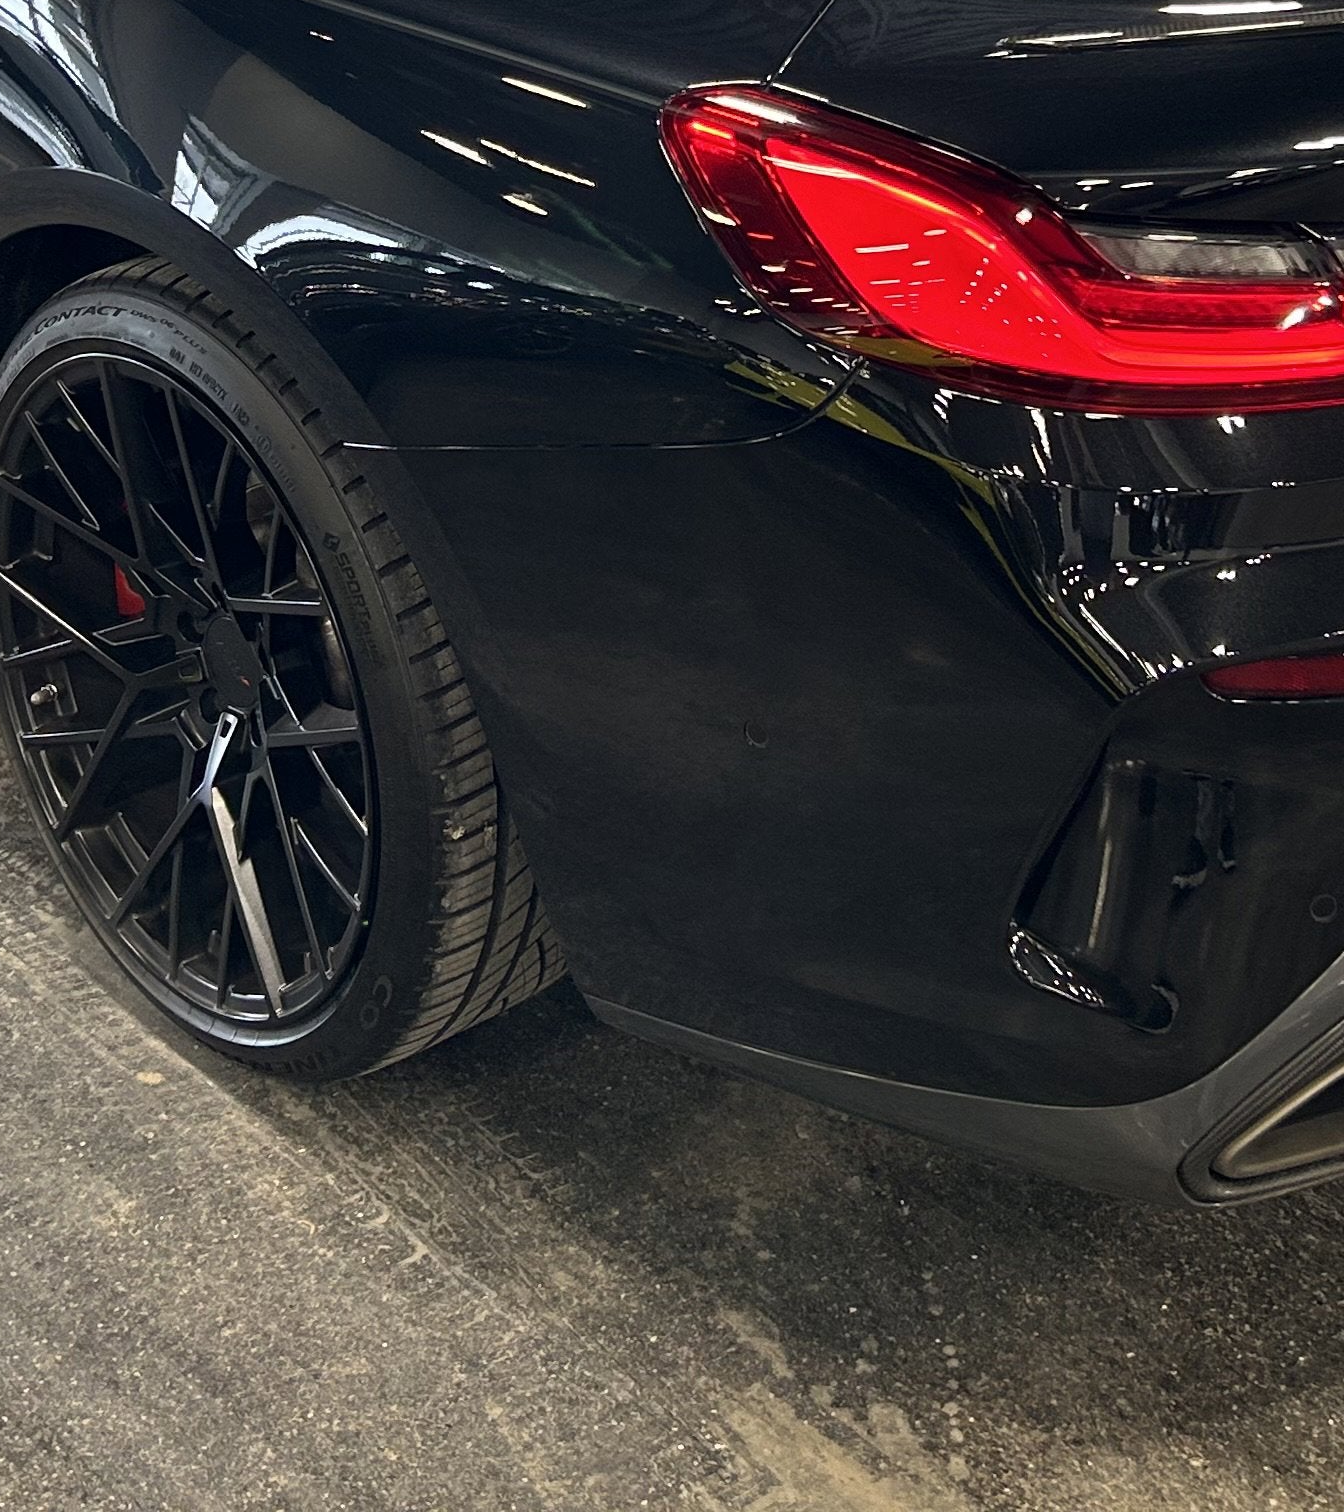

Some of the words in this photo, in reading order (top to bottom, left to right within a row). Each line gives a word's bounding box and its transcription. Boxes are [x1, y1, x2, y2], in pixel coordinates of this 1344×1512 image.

[130, 309, 157, 324] DWS
[159, 317, 175, 330] 06
[173, 329, 208, 355] PLUS
